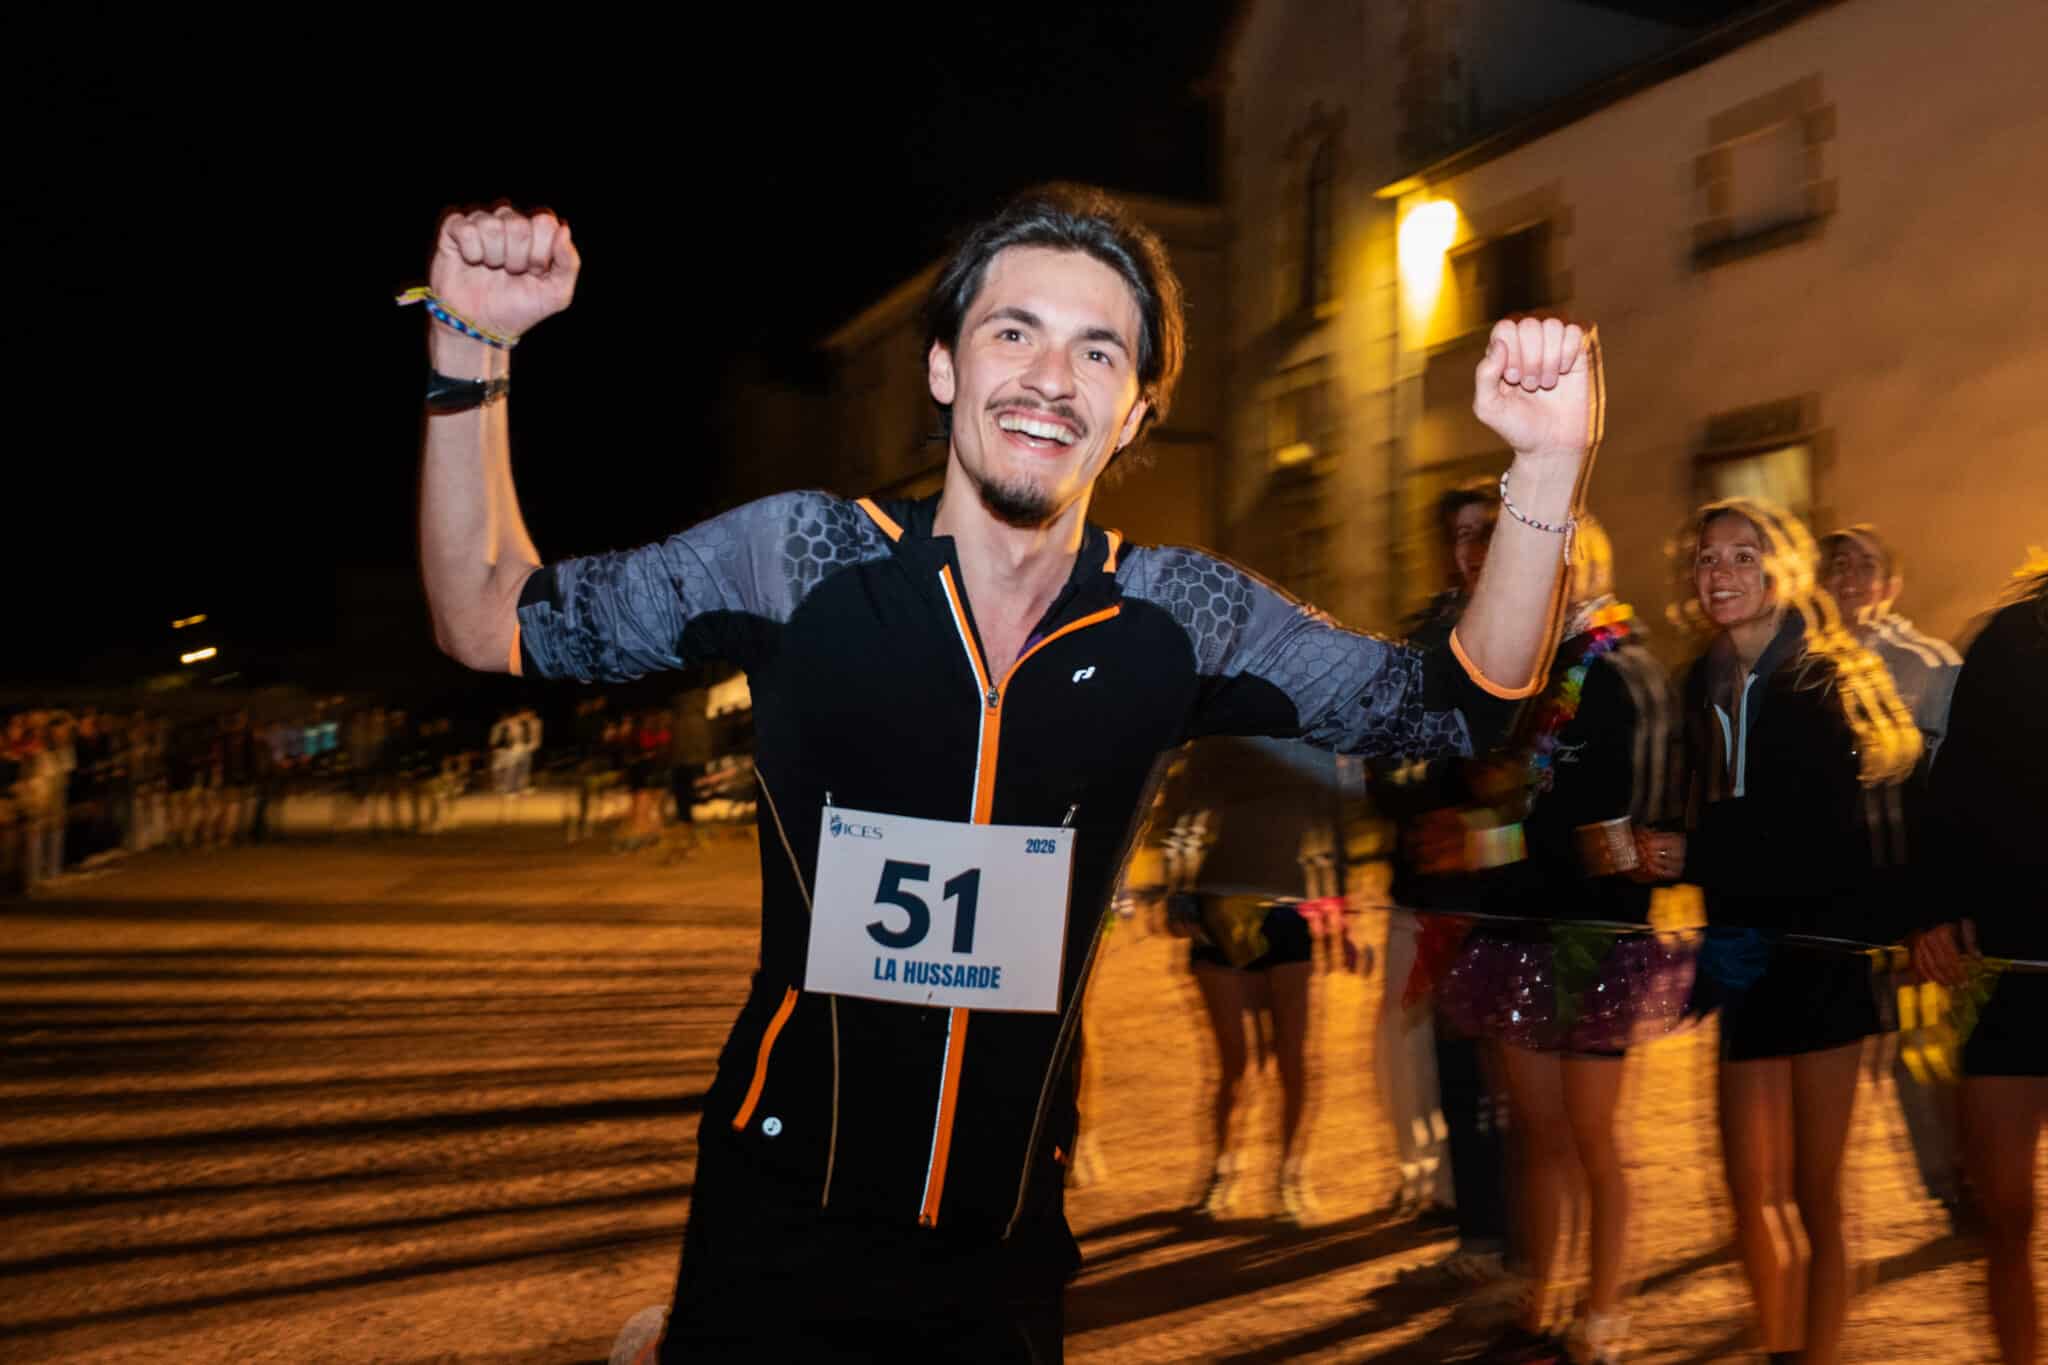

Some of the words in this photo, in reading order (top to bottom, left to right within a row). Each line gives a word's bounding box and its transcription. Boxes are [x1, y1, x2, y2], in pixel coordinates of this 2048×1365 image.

[844, 824, 883, 840] ICES
[1025, 838, 1056, 854] 2026
[865, 858, 981, 954] 51
[874, 957, 897, 981] LA
[903, 961, 1001, 989] HUSSARDE
